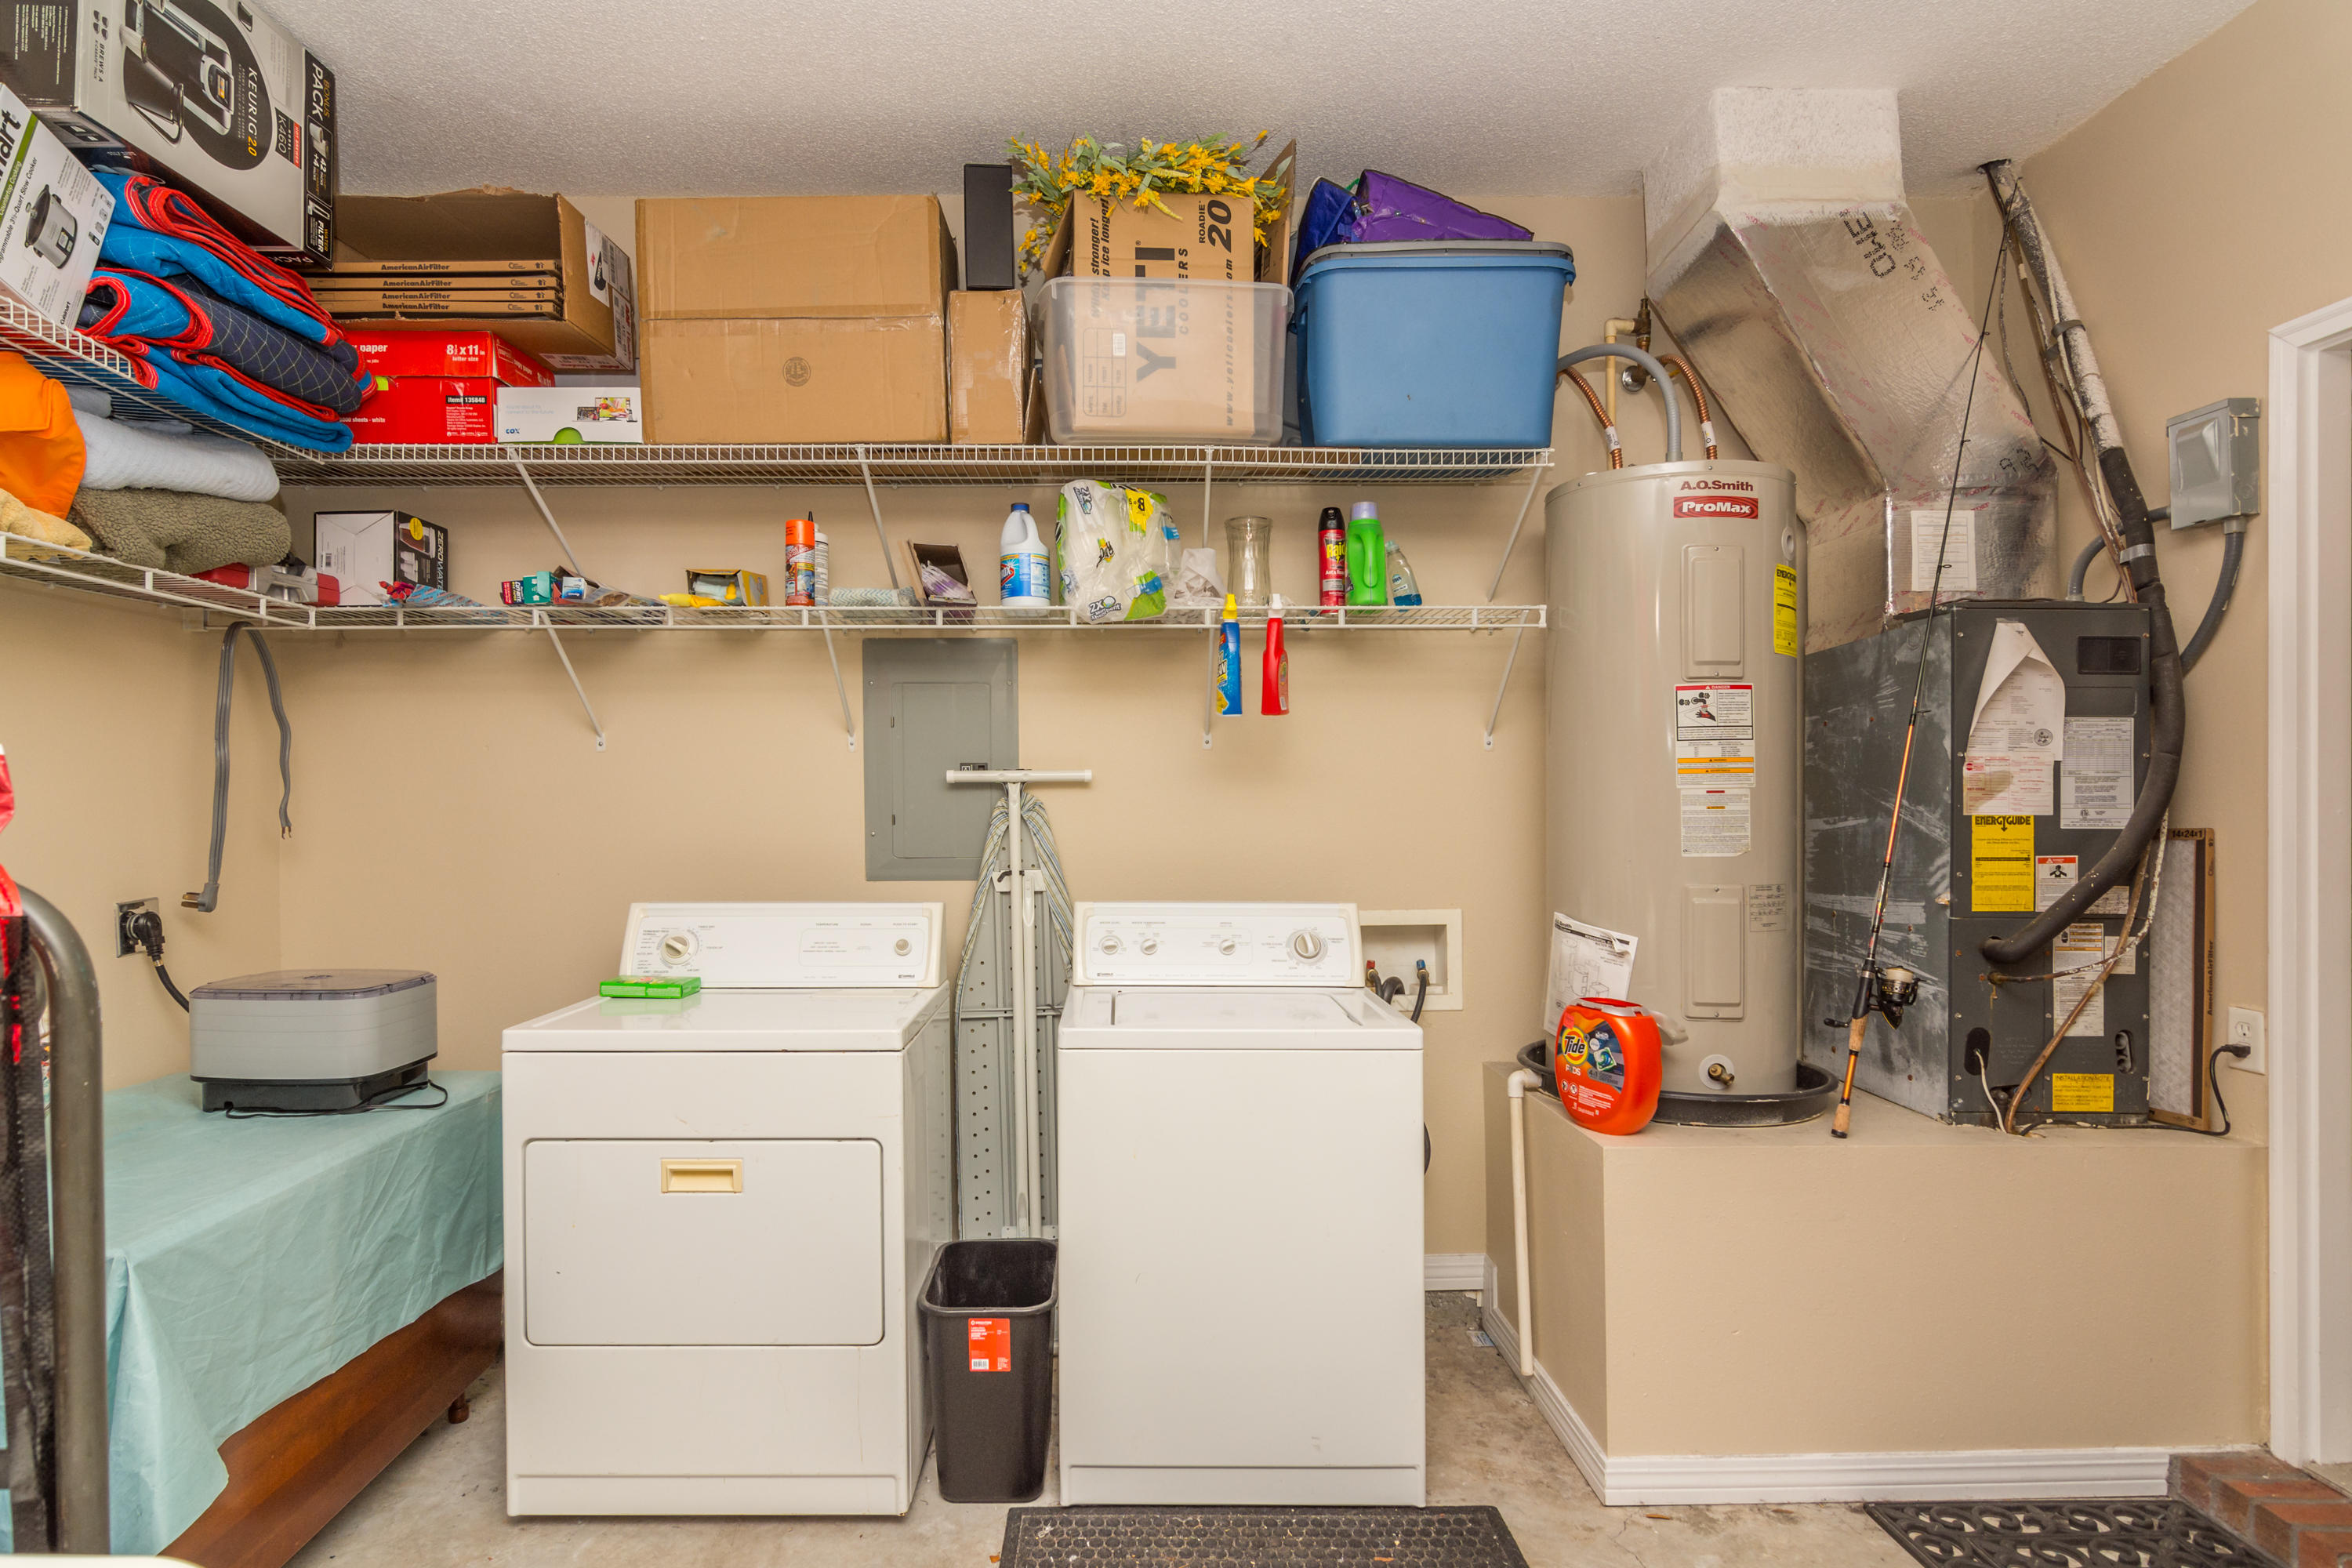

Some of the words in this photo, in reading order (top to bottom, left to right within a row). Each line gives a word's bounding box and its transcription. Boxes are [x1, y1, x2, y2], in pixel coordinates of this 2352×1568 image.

[248, 67, 257, 134] KEURIG
[312, 63, 324, 122] PACK
[247, 136, 257, 156] 2.0
[278, 114, 288, 154] K460
[20, 176, 31, 197] Slow
[27, 157, 38, 180] Cooker
[321, 158, 327, 171] 42
[1101, 198, 1110, 243] longer!
[1207, 200, 1232, 252] 20
[1090, 218, 1101, 274] stronger!
[1101, 245, 1109, 266] ice
[1178, 248, 1188, 335] COOLERS
[60, 301, 71, 326] Cuisinart
[1134, 247, 1176, 381] YETI
[360, 343, 388, 354] paper
[467, 345, 479, 354] 11
[1225, 260, 1233, 426] www.yeticoolers.om
[1680, 480, 1754, 492] A.O.Smith
[1682, 501, 1751, 514] ProMax
[1089, 601, 1104, 614] 2X
[1975, 815, 2031, 826] ENERGYGUIDE
[1564, 1036, 1586, 1056] Tide
[1565, 1064, 1581, 1076] PODS
